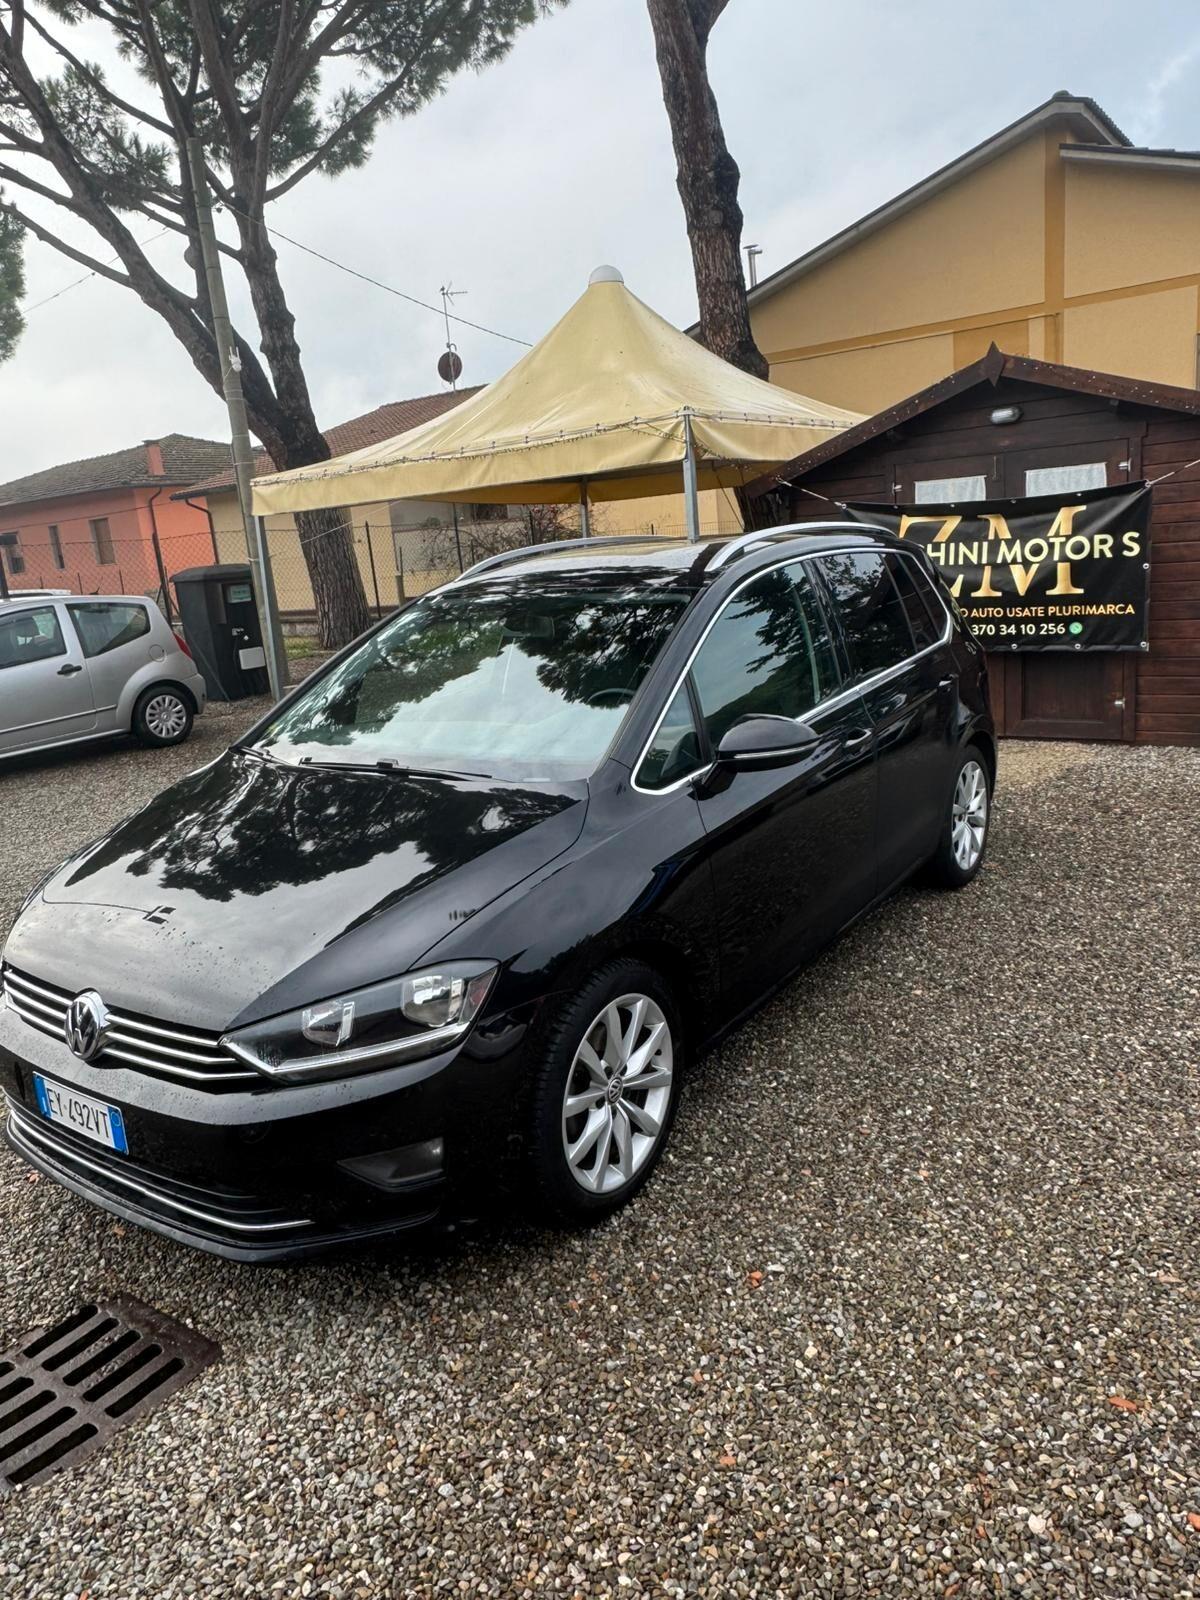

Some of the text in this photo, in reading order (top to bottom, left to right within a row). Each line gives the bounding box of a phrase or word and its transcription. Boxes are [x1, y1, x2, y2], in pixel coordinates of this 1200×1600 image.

[970, 607, 1004, 618] AUTO
[1006, 606, 1046, 617] USATE
[1048, 603, 1136, 617] PLURIMARCA
[971, 623, 1066, 635] 370 34 10 256
